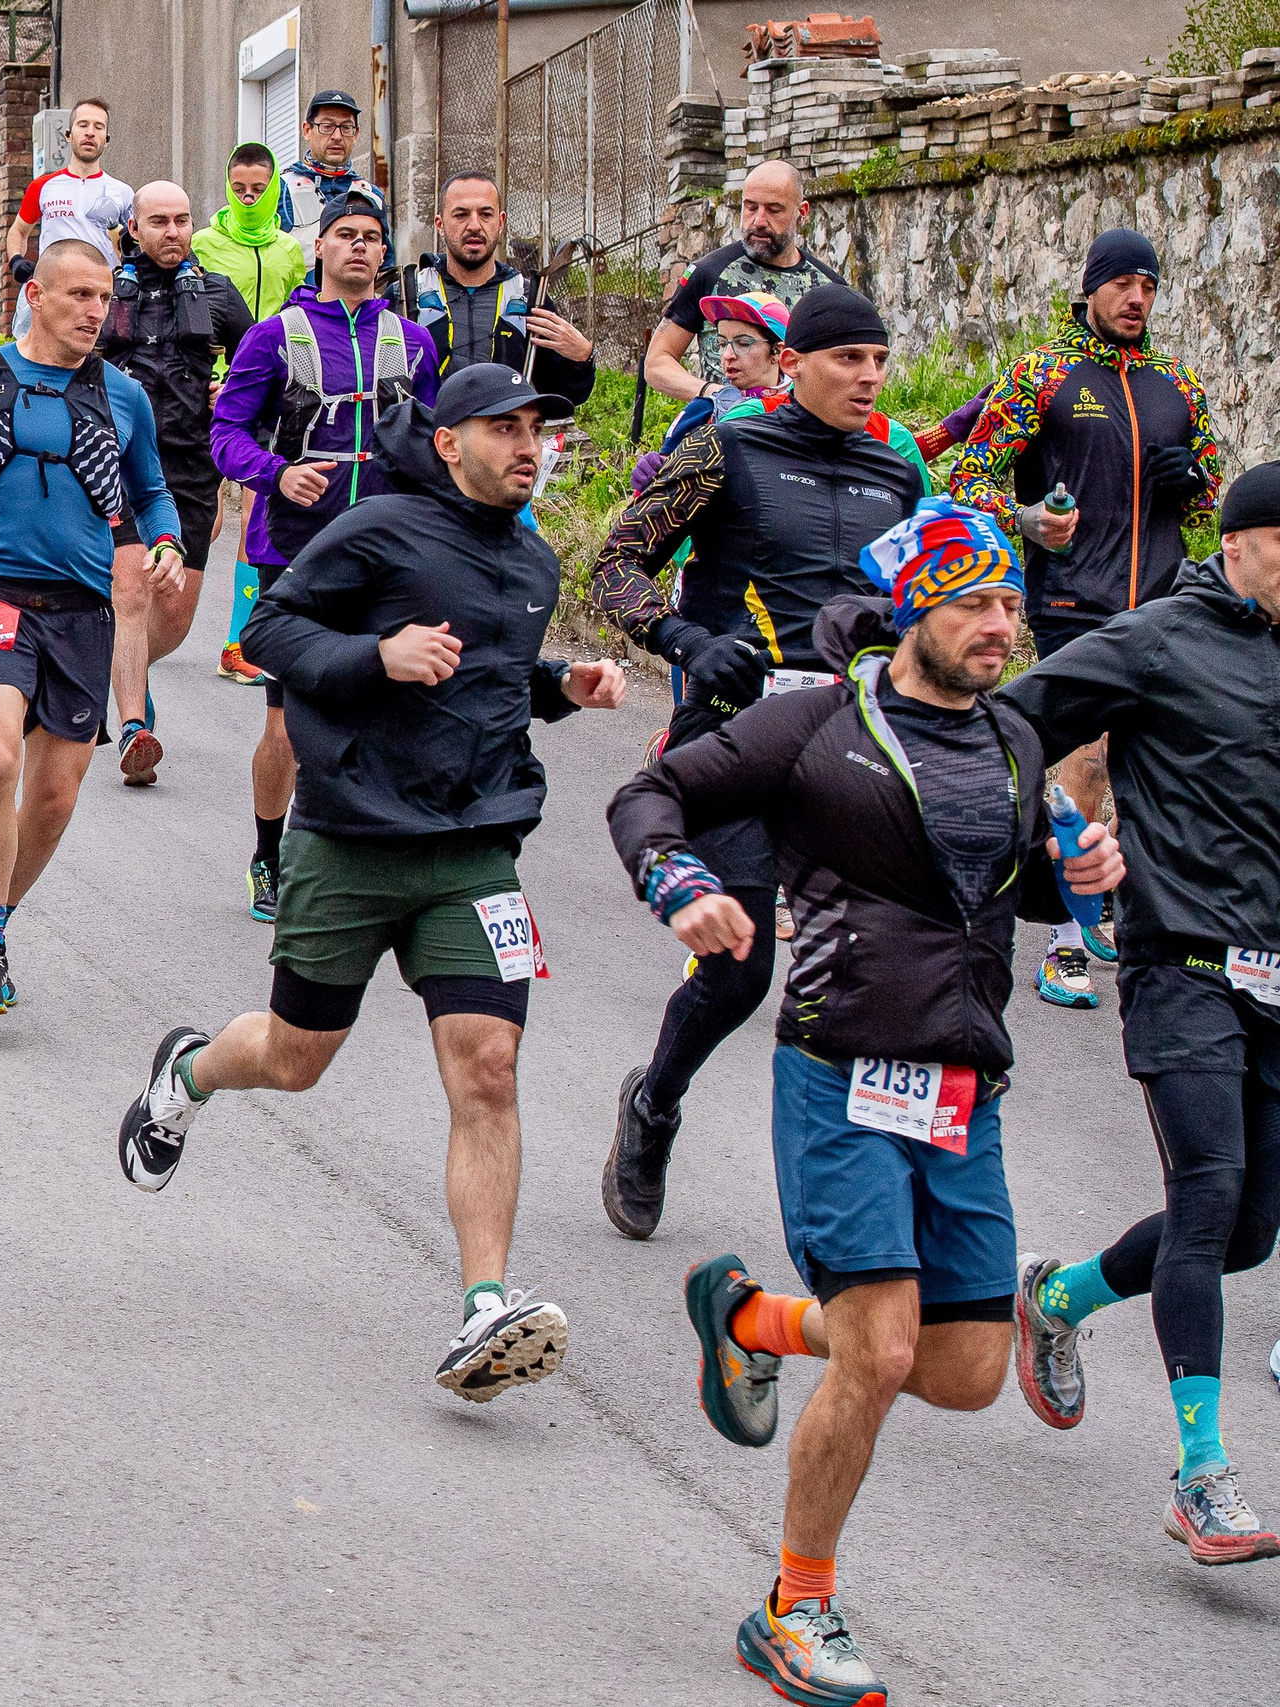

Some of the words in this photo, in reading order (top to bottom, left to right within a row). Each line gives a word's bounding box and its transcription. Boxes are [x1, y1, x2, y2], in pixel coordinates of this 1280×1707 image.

[42, 199, 74, 209] EMINE
[801, 676, 816, 686] 22K
[860, 1058, 931, 1100] 2133
[855, 1088, 891, 1105] MARKOVO
[891, 1096, 910, 1111] TRAIL
